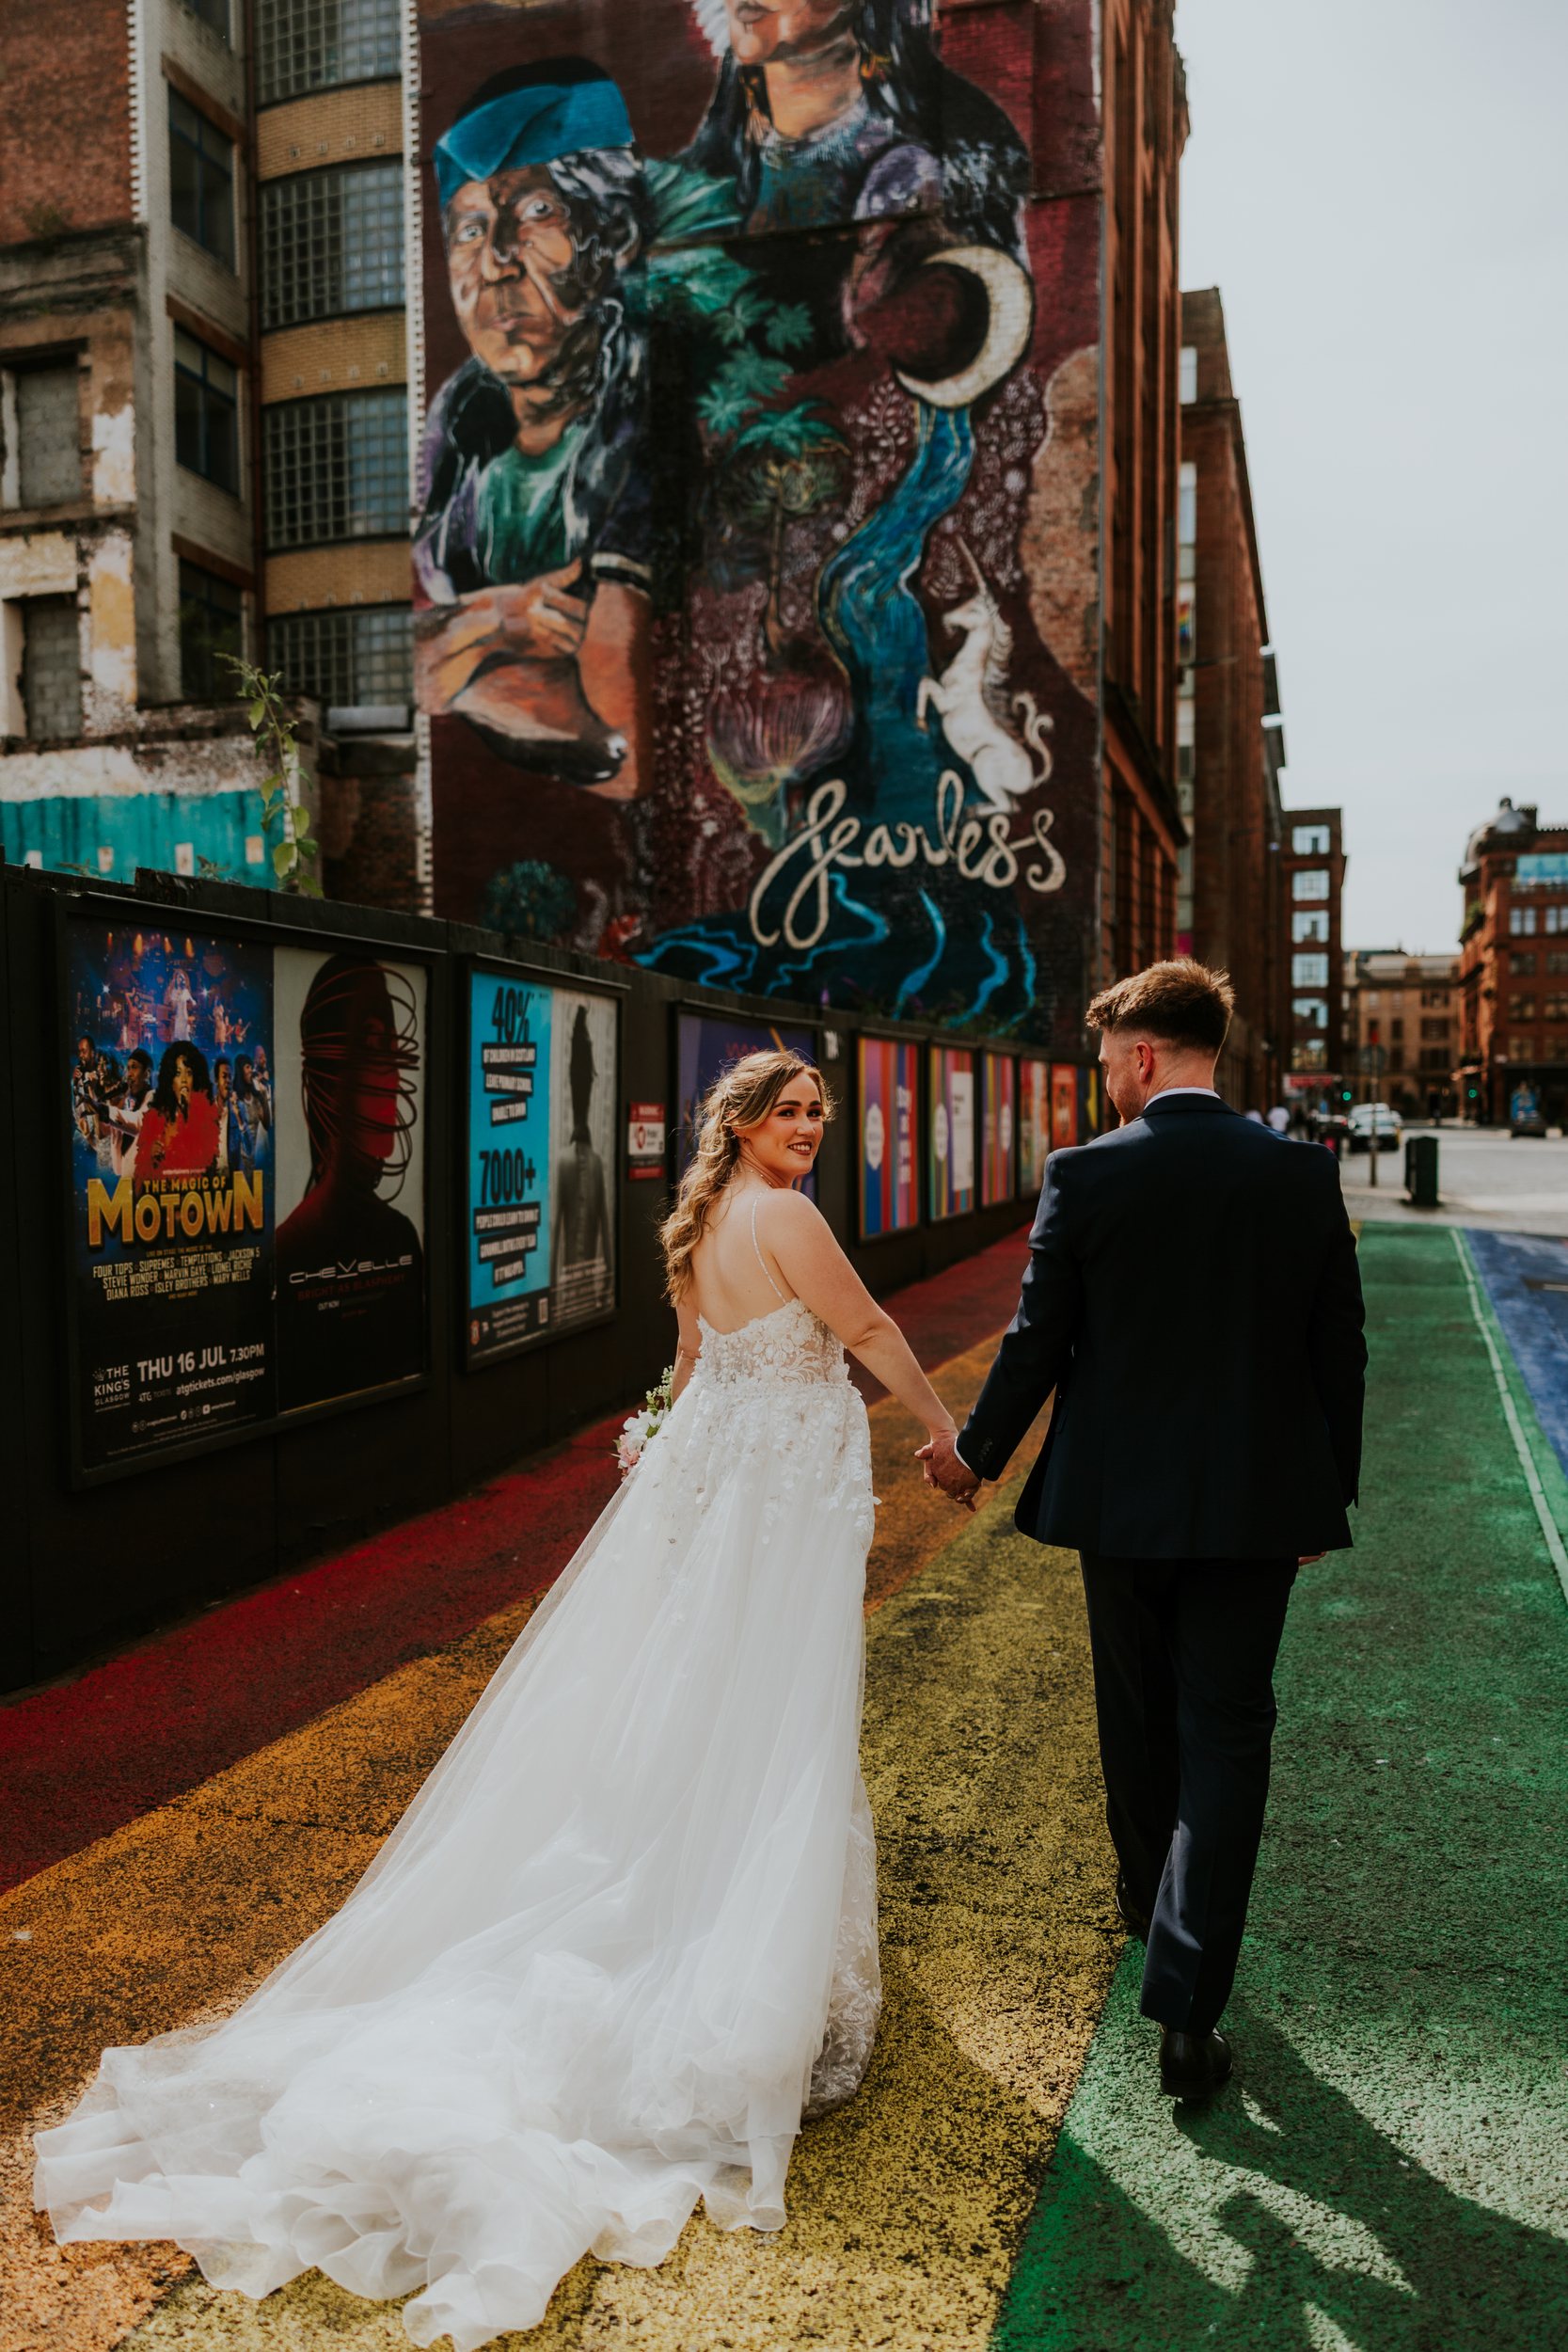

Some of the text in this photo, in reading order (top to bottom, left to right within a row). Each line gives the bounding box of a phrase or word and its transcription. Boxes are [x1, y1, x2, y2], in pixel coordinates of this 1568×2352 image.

[144, 1176, 227, 1193] THE MAGIC OF
[479, 1147, 536, 1205] 7000+
[87, 1170, 264, 1248] MOTOWN
[93, 1264, 114, 1279] FOUR
[115, 1263, 134, 1276] TOPS
[139, 1257, 175, 1273] SUPREMES
[181, 1252, 223, 1267] TEMPTATIONS
[228, 1248, 254, 1262] JACKSON
[103, 1276, 128, 1290] STEVIE
[130, 1271, 159, 1286] WONDER
[164, 1268, 189, 1282] MARVIN
[190, 1265, 208, 1279] GAYE
[213, 1263, 231, 1275] LIONEL
[106, 1271, 251, 1302] DIANA ROSS ISLEY BROTHERS MARY WELLS
[297, 1286, 335, 1302] BRIGHT
[339, 1284, 351, 1295] AS
[107, 1365, 130, 1379] THE
[137, 1343, 265, 1383] THU 16 JUL 7.30PM
[95, 1379, 131, 1397] KING'S
[177, 1368, 265, 1396] atgtickets.com/glasgow
[95, 1392, 131, 1406] GLASGOW
